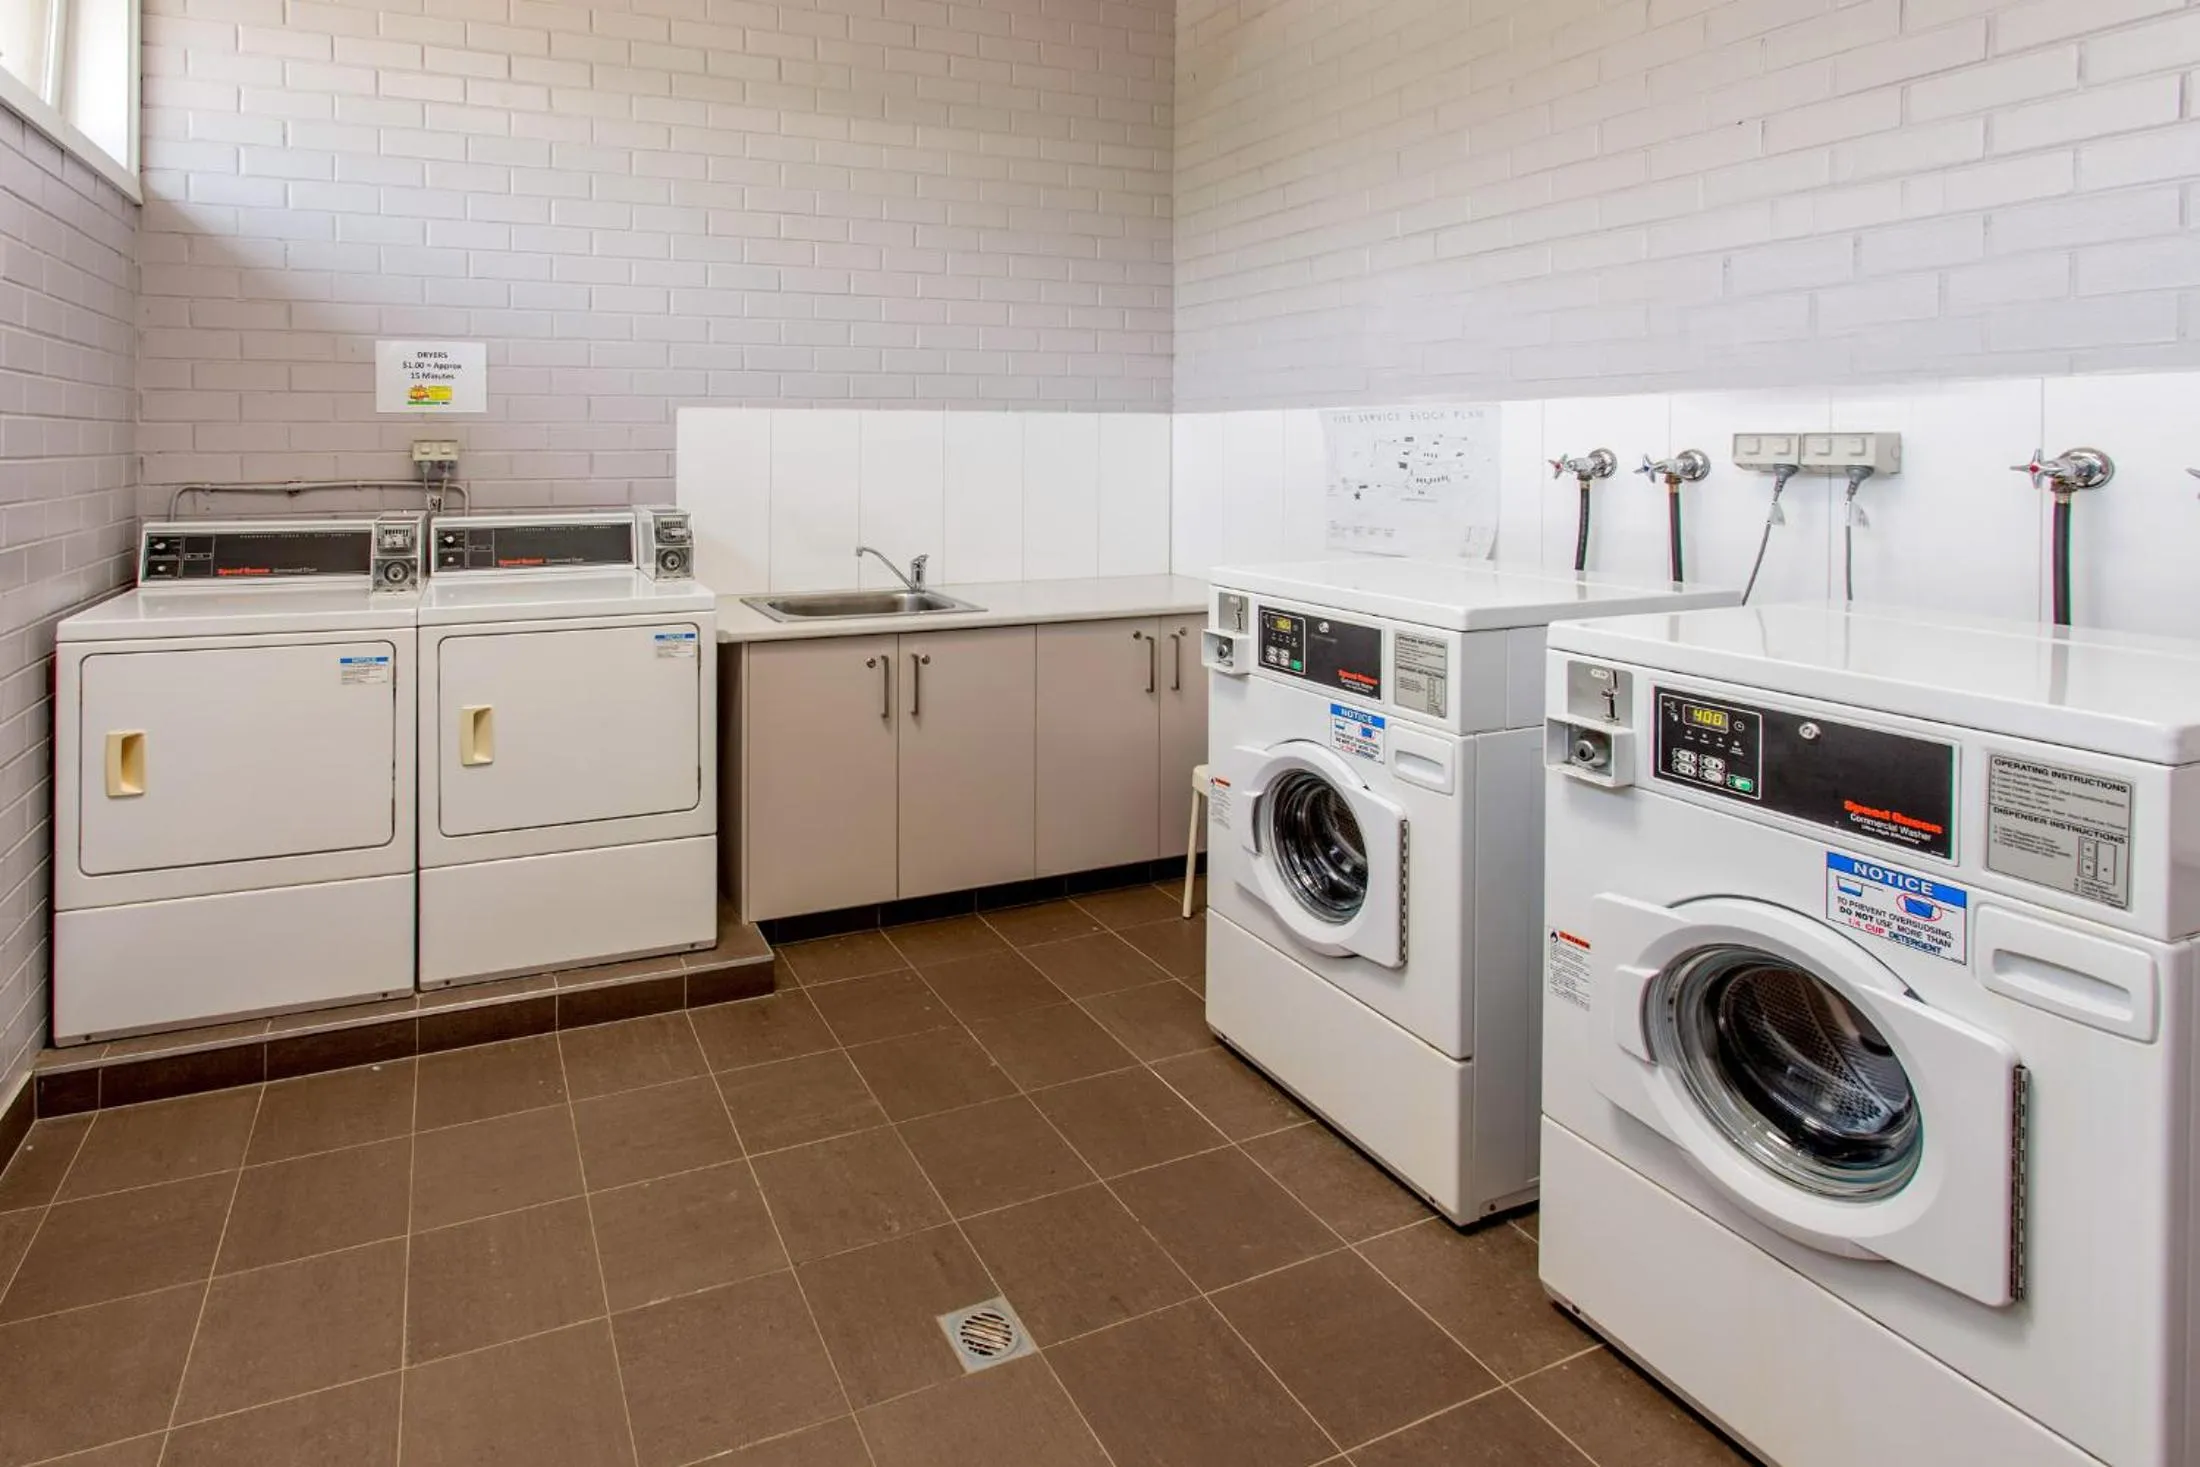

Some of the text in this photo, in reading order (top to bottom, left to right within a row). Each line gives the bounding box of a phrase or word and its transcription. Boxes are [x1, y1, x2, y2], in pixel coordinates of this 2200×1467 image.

[403, 361, 425, 369] $1.00
[422, 372, 455, 380] Minutes
[1358, 412, 1400, 423] SERVICE
[1341, 708, 1372, 724] NOTICE
[1994, 759, 2127, 793] OPERATING INSTRUCTIONS
[1844, 800, 1942, 833] Speed Queen
[1850, 812, 1932, 841] Commercial Washer
[1993, 806, 2048, 825] DISPENSER
[2050, 821, 2126, 844] INSTRUCTIONS
[1854, 862, 1933, 896] NOTICE
[1837, 896, 1954, 940] TO PREVENT OVERSUDSING,
[1839, 906, 1951, 948] DO NOT USE MORE THAN
[1848, 918, 1942, 954] 1/4 CUP DETERGENT
